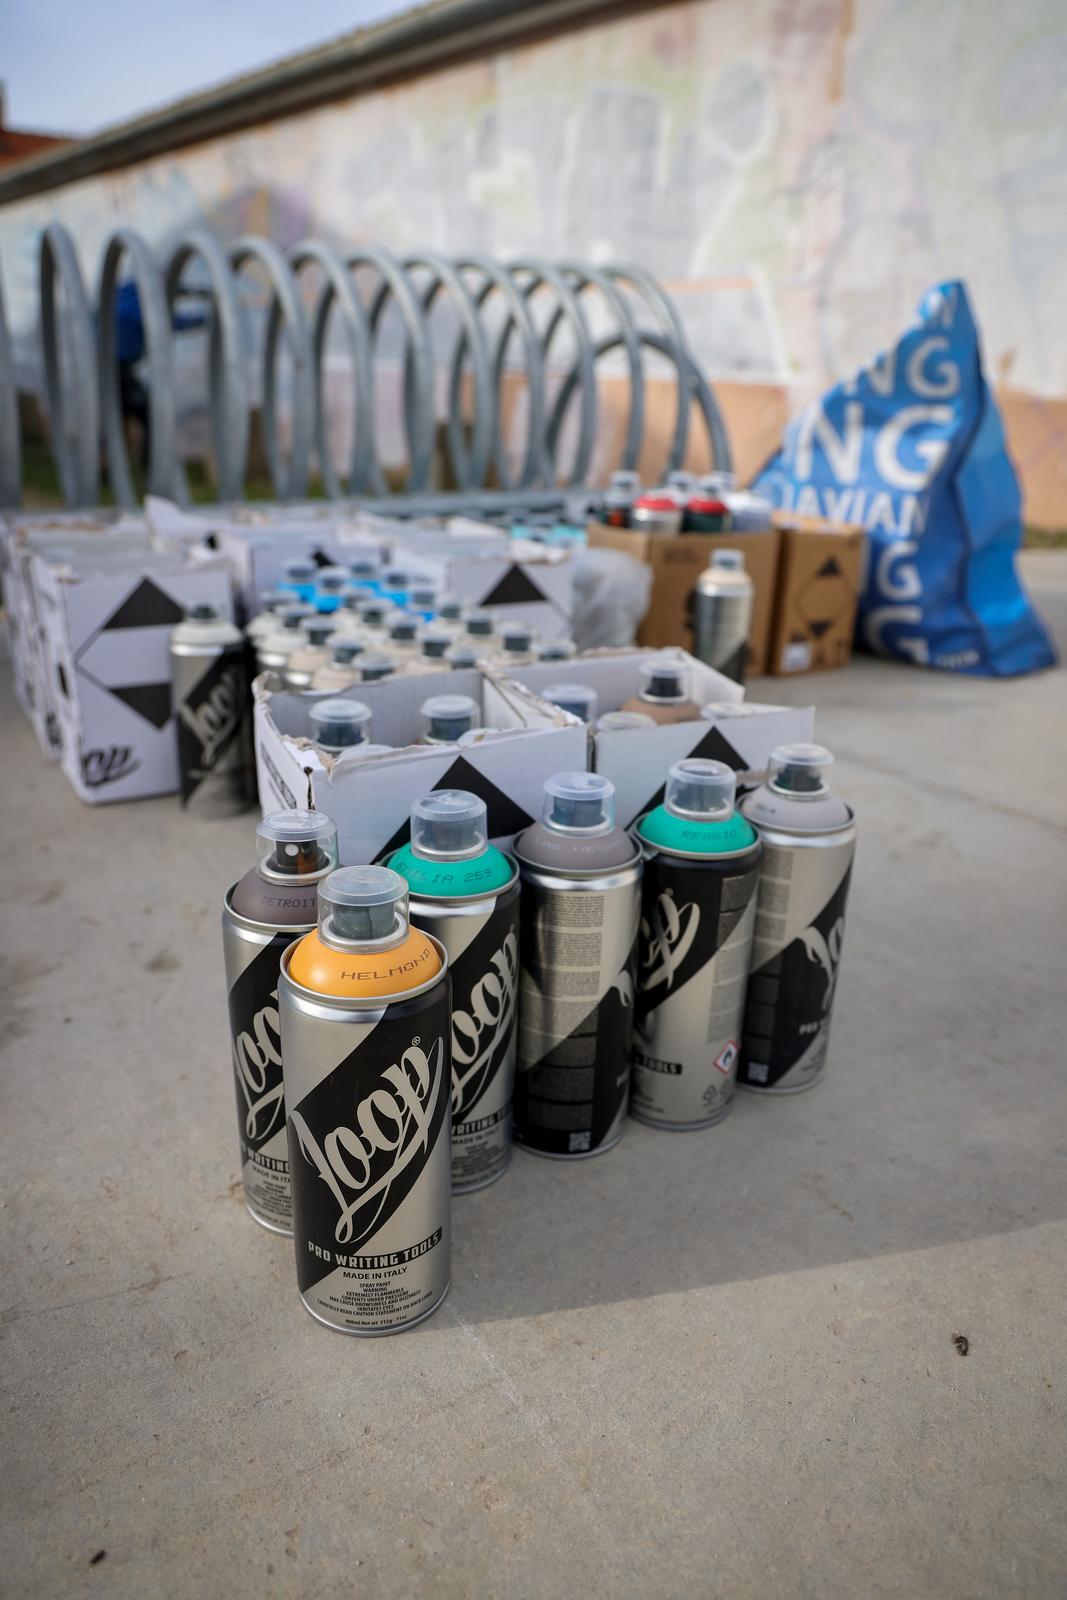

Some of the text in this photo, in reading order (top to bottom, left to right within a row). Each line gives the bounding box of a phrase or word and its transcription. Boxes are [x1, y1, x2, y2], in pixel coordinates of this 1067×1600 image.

[463, 868, 493, 883] 259
[263, 896, 316, 909] DETROIT
[340, 948, 430, 980] HELMOND
[308, 1233, 440, 1269] PRO WRITING TOOLS
[343, 1266, 408, 1280] MADE IN ITALY
[374, 1287, 405, 1297] FLAMMABLE
[384, 1290, 409, 1301] PRESSURE
[353, 1309, 375, 1317] CAUTION
[375, 1306, 403, 1316] STATEMENT
[403, 1303, 410, 1311] ON
